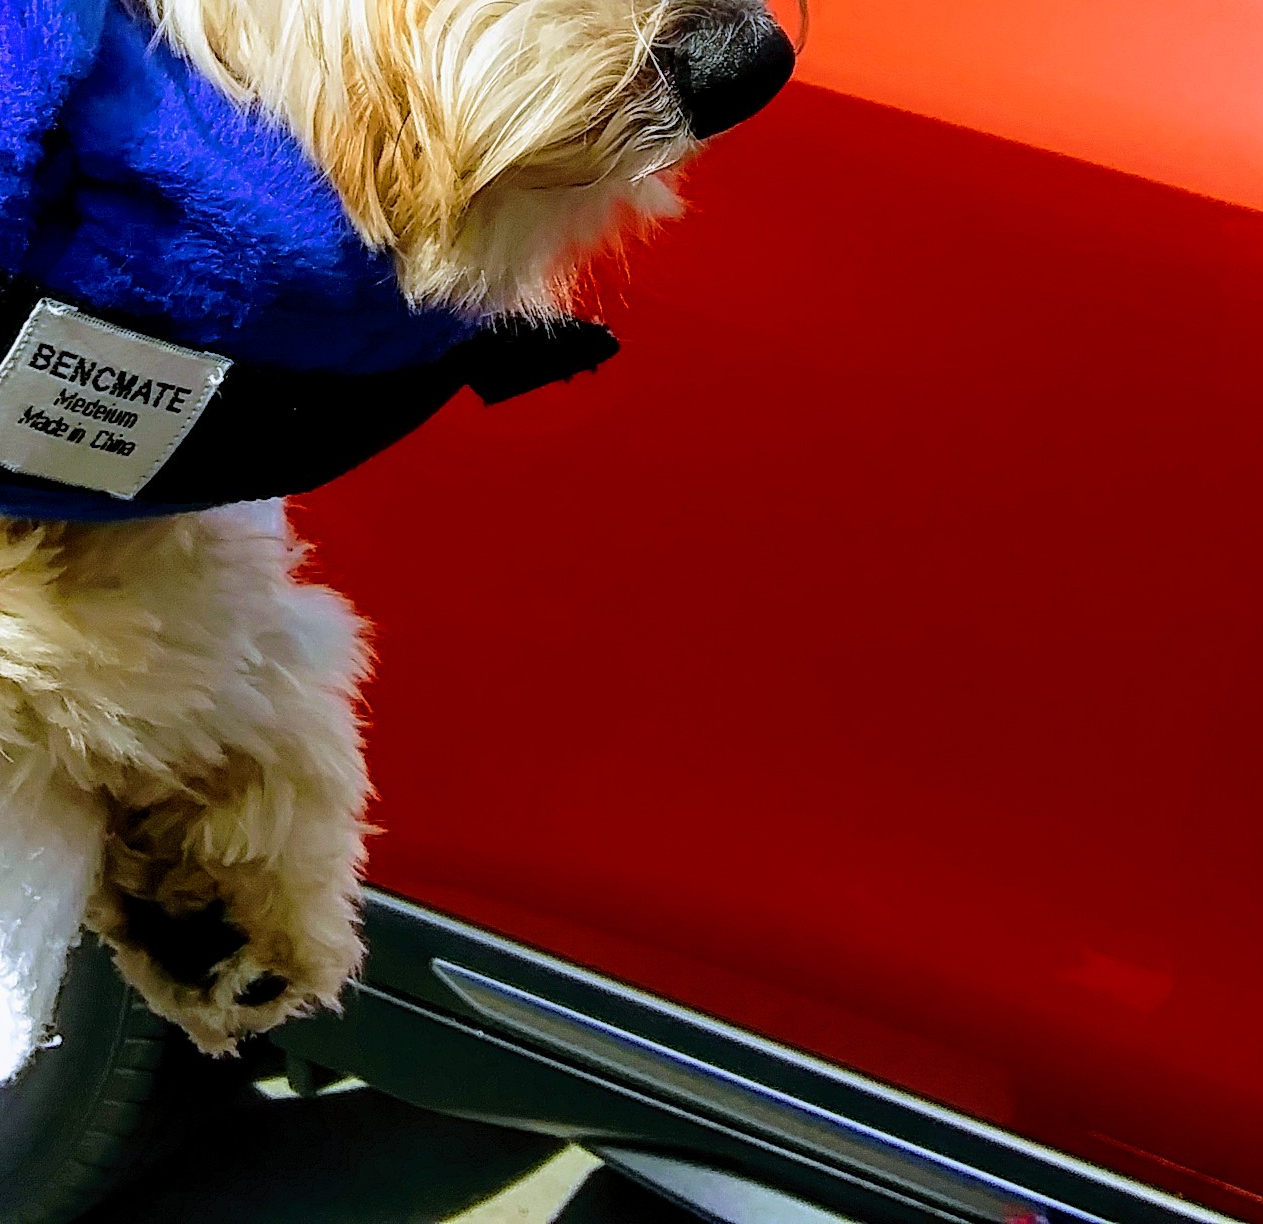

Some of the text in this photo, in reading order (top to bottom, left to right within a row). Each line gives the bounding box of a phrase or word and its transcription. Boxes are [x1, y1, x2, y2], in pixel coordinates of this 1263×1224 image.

[28, 343, 192, 414] BENCMATE
[18, 405, 136, 456] Made in China
[54, 388, 138, 429] Medeium
